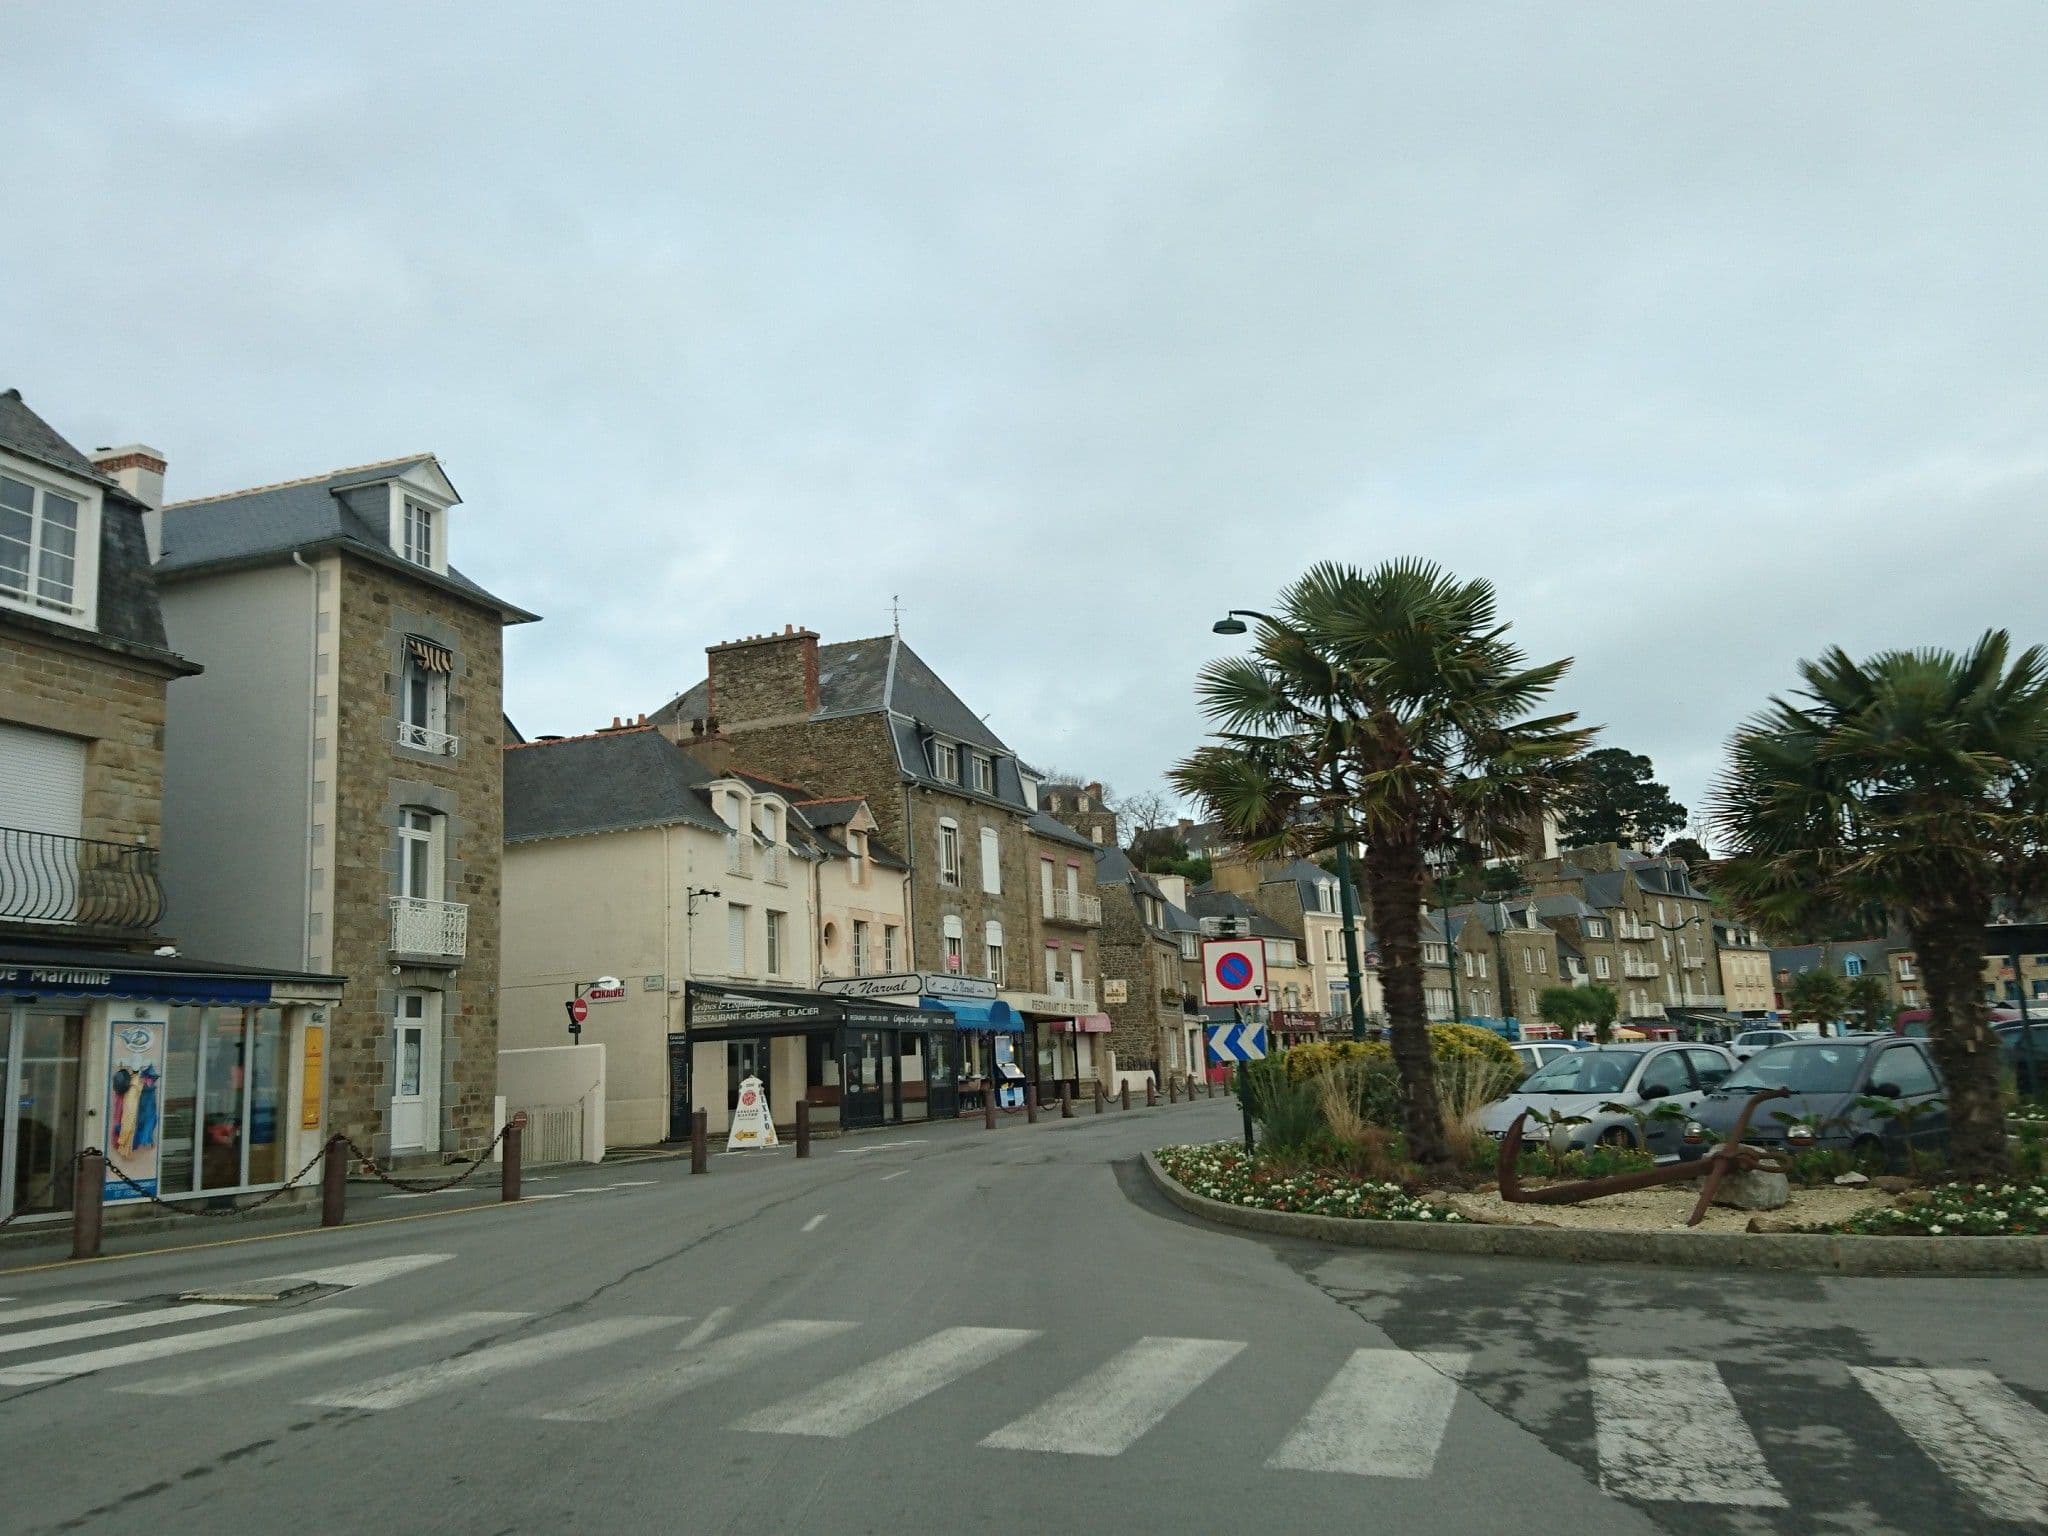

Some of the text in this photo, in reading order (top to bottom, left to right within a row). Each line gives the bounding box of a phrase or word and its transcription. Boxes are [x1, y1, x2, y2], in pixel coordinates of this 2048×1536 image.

[30, 970, 111, 985] Maritime
[859, 980, 907, 994] Narval
[692, 1012, 740, 1024] RESTAURANT
[787, 1007, 819, 1017] GLACIER
